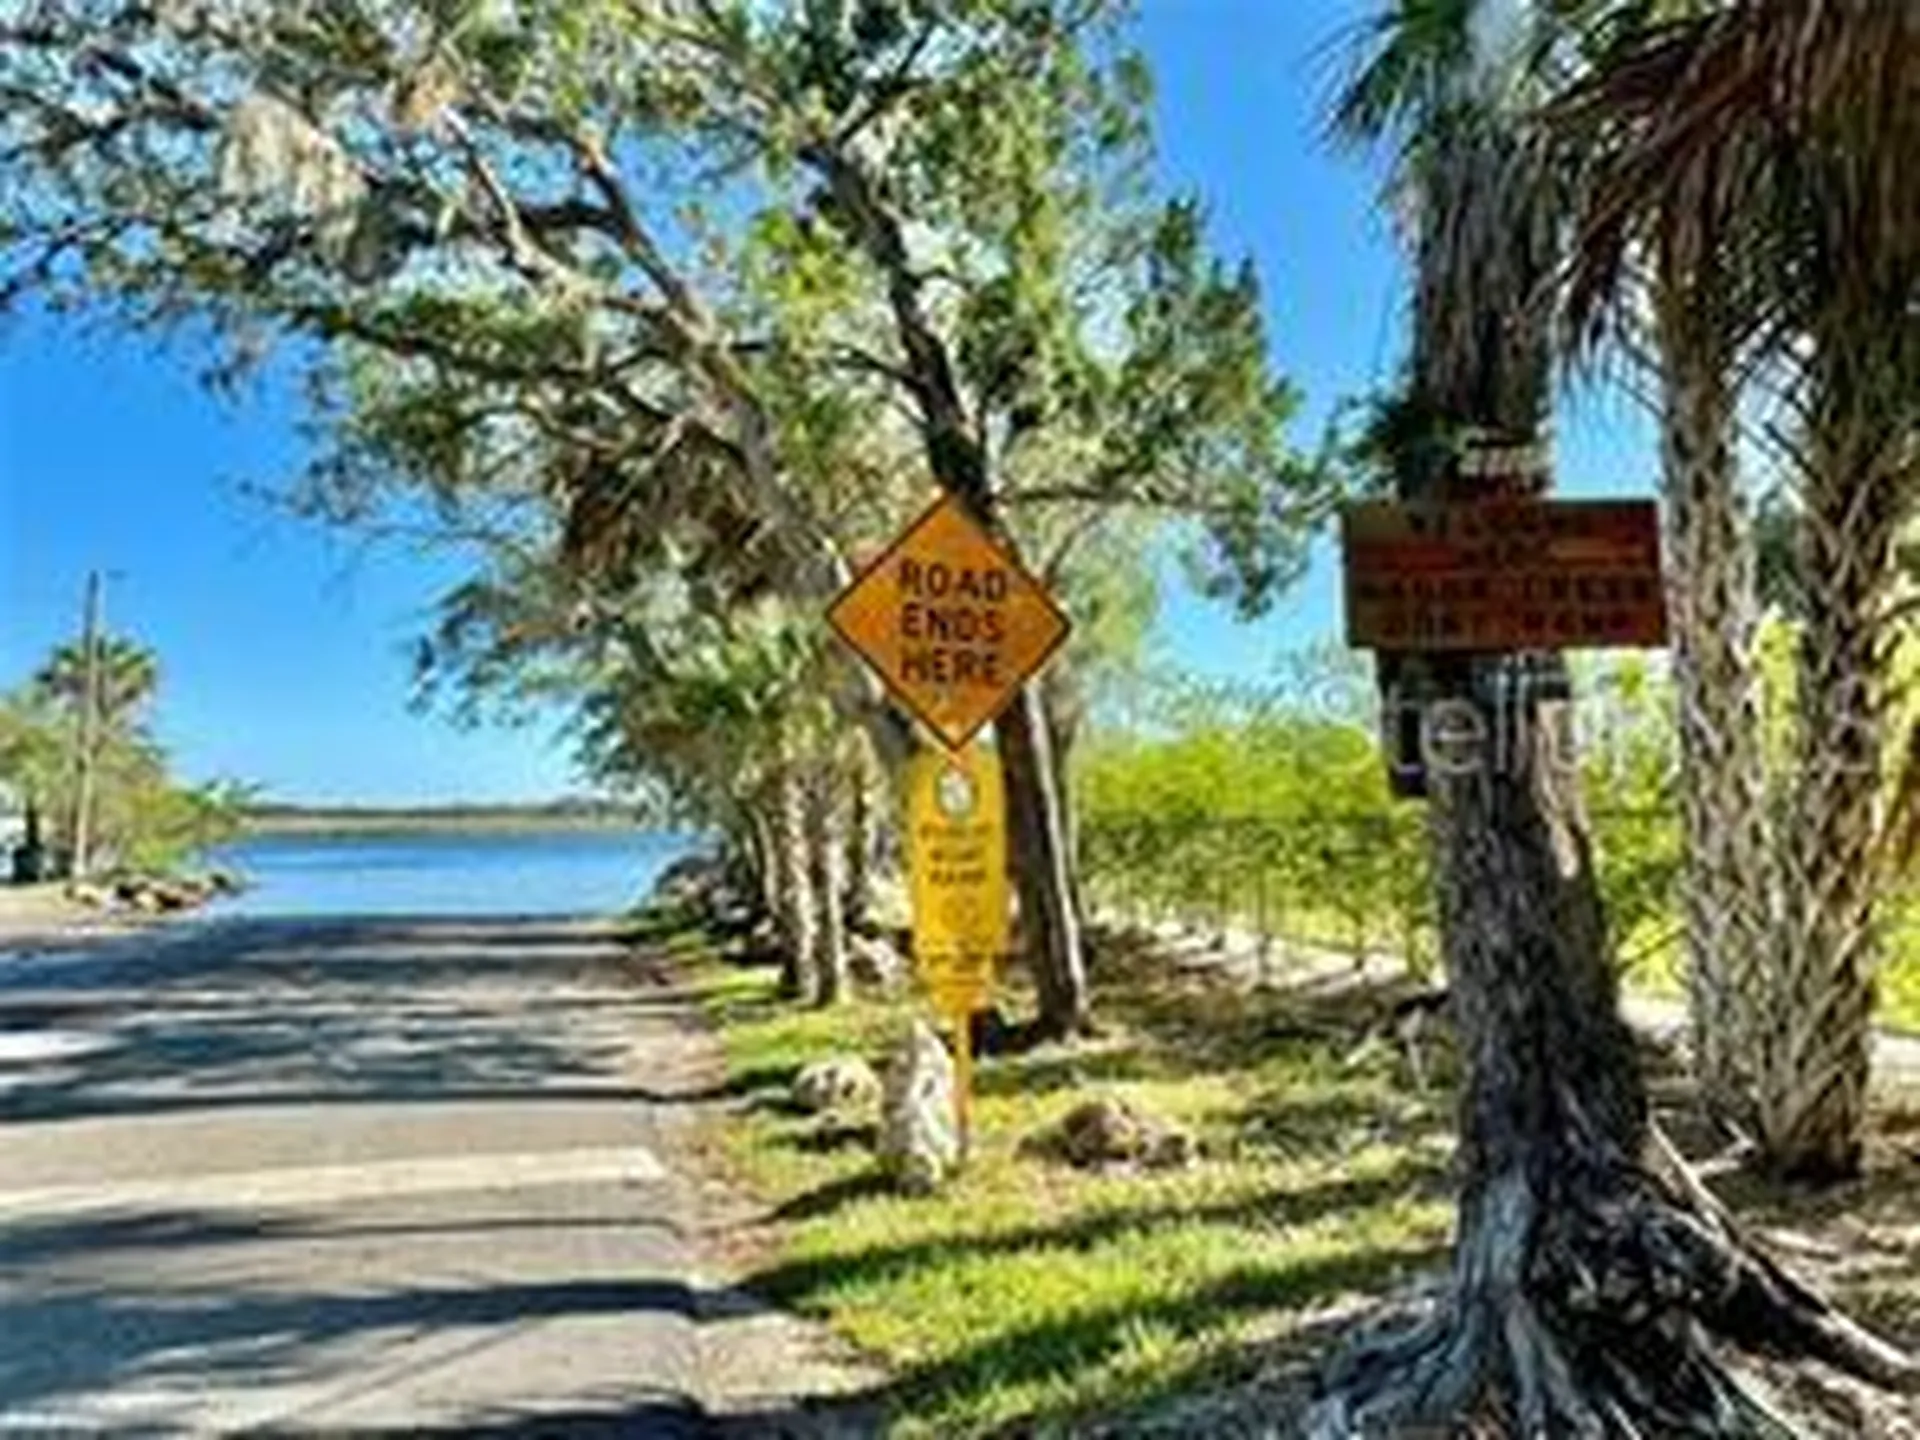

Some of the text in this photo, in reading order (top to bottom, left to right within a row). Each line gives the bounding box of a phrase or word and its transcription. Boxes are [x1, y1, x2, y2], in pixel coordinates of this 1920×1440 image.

[901, 558, 1006, 601] ROAD
[902, 602, 1004, 643] ENDS
[901, 648, 1004, 688] HERE
